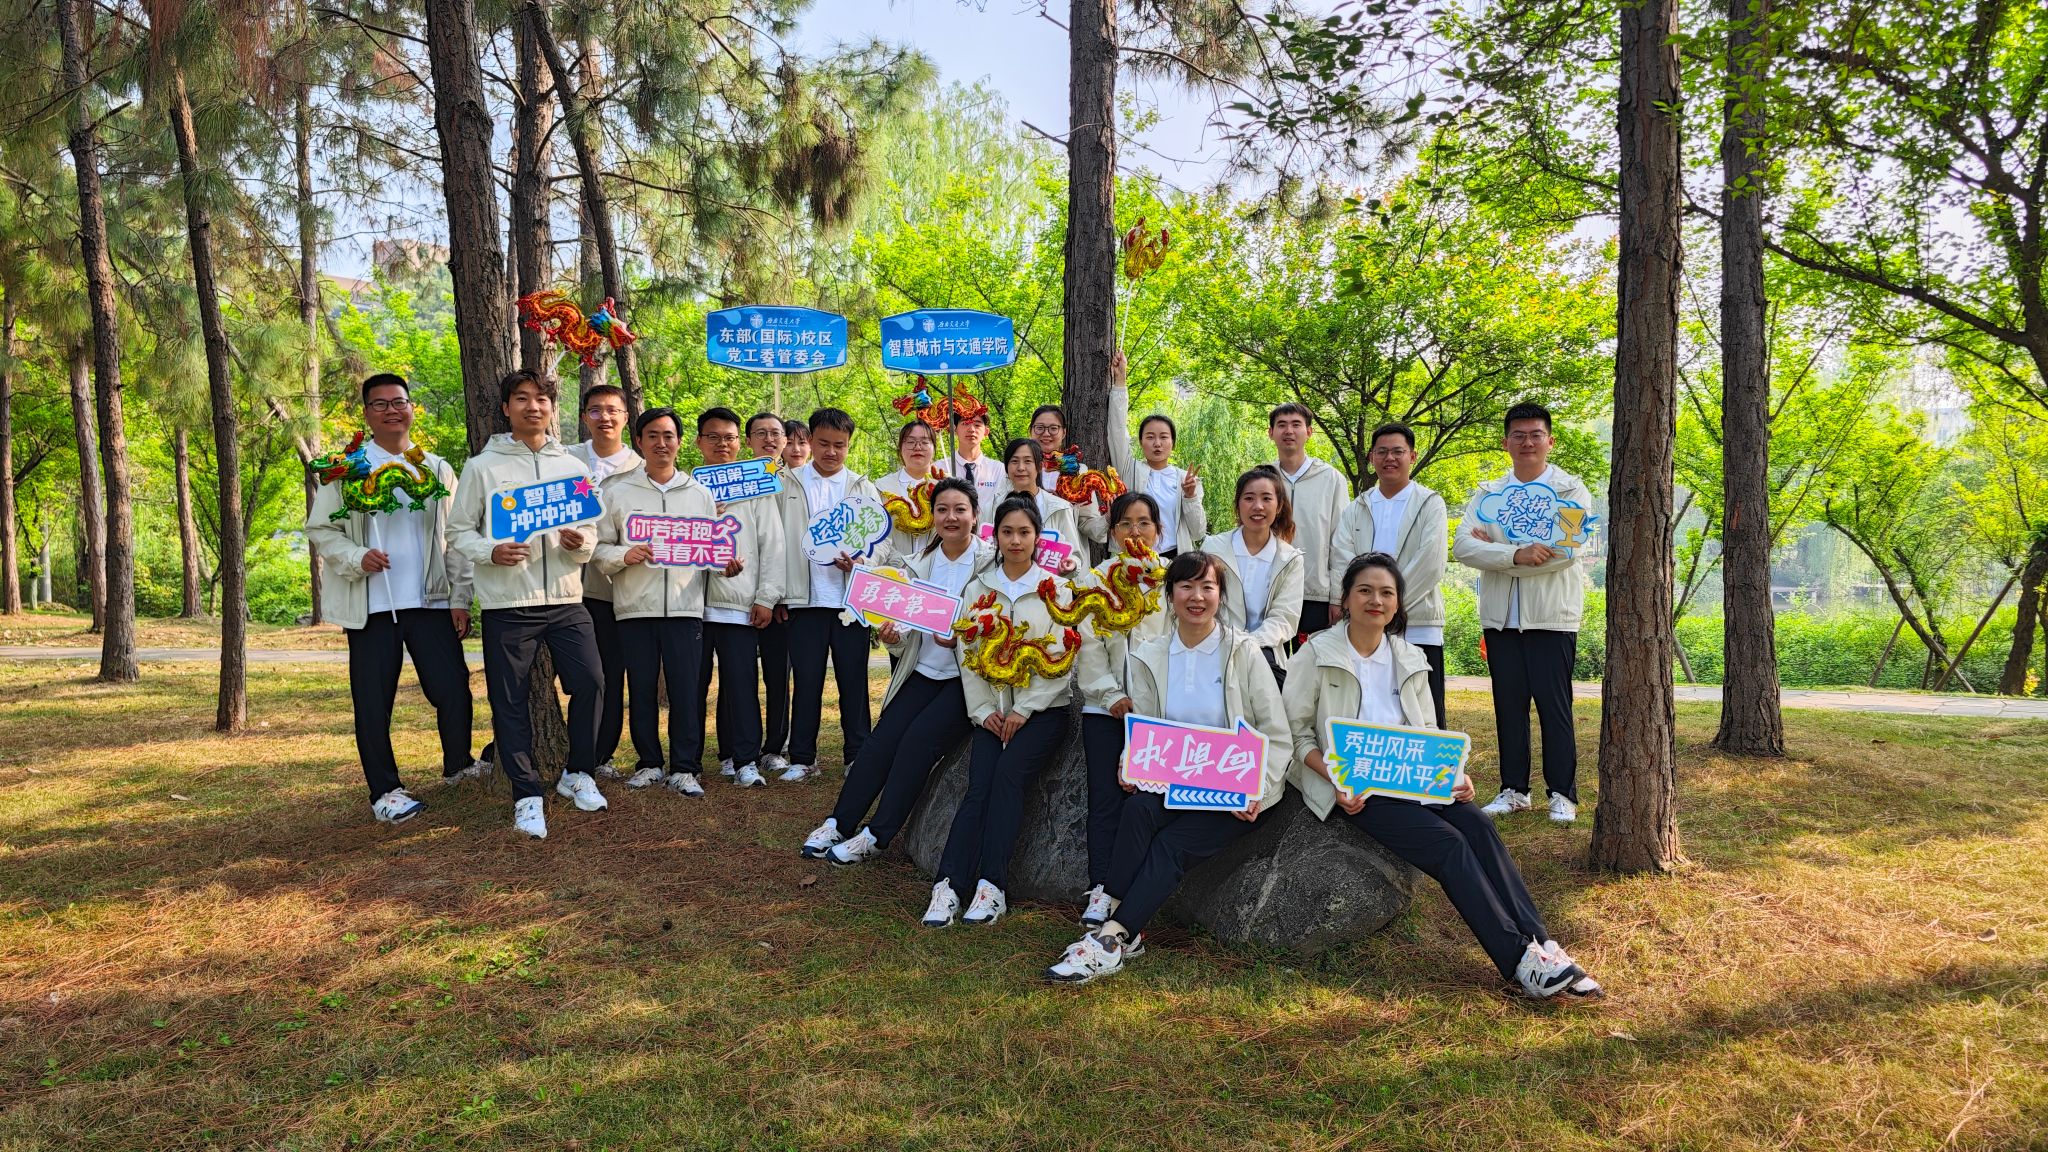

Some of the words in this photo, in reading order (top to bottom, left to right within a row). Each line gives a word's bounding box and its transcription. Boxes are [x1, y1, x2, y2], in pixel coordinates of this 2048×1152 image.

[726, 347, 826, 367] 党工委管委会
[889, 336, 1008, 358] 智慧城市与交通学院
[695, 466, 759, 486] 友谊第一
[523, 482, 567, 508] 智慧
[711, 477, 775, 501] 比赛第二
[510, 499, 583, 533] 冲冲冲
[630, 518, 712, 541] 你若奔跑
[651, 540, 733, 565] 青春不老
[859, 581, 947, 618] 勇争第一
[1131, 729, 1256, 783] 向前冲
[1344, 731, 1427, 762] 秀出风采
[1352, 757, 1435, 788] 赛出水平
